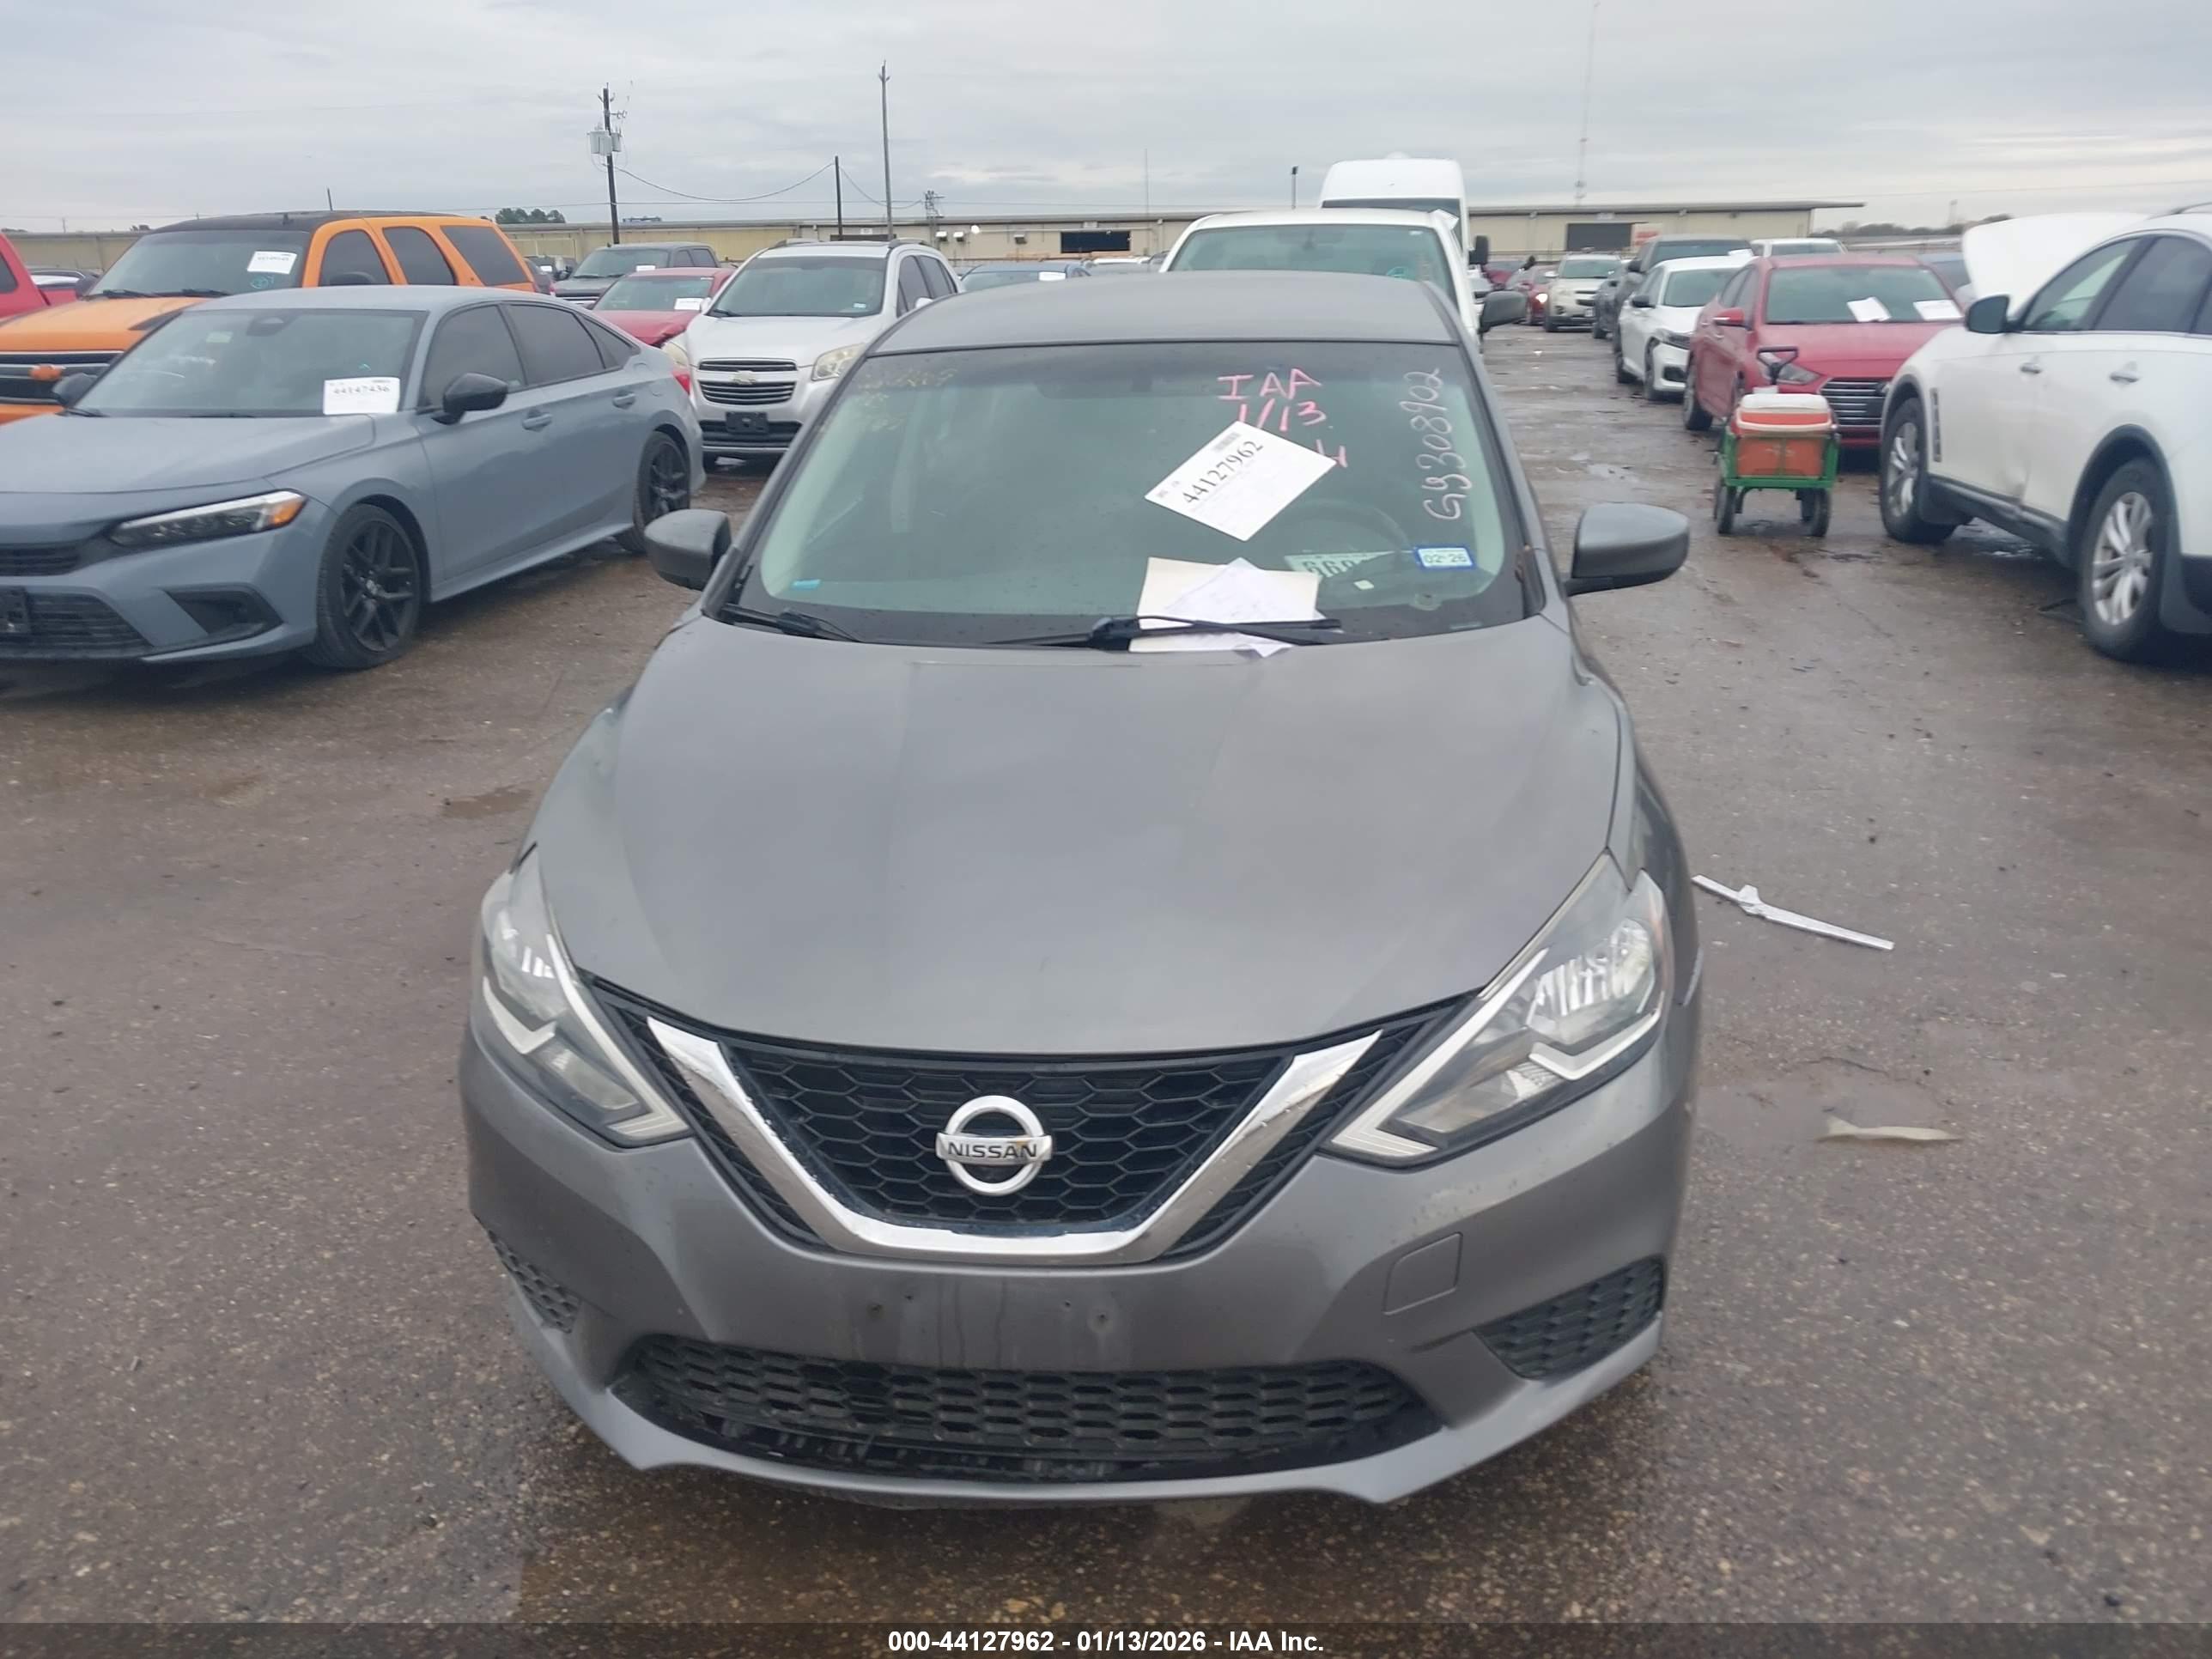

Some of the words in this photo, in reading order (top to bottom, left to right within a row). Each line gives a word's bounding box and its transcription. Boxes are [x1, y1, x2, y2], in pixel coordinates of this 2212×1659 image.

[1217, 368, 1322, 400] IAA
[1237, 398, 1328, 431] 1/13
[1182, 441, 1264, 503] 44127962
[947, 1141, 1037, 1159] NISSAN
